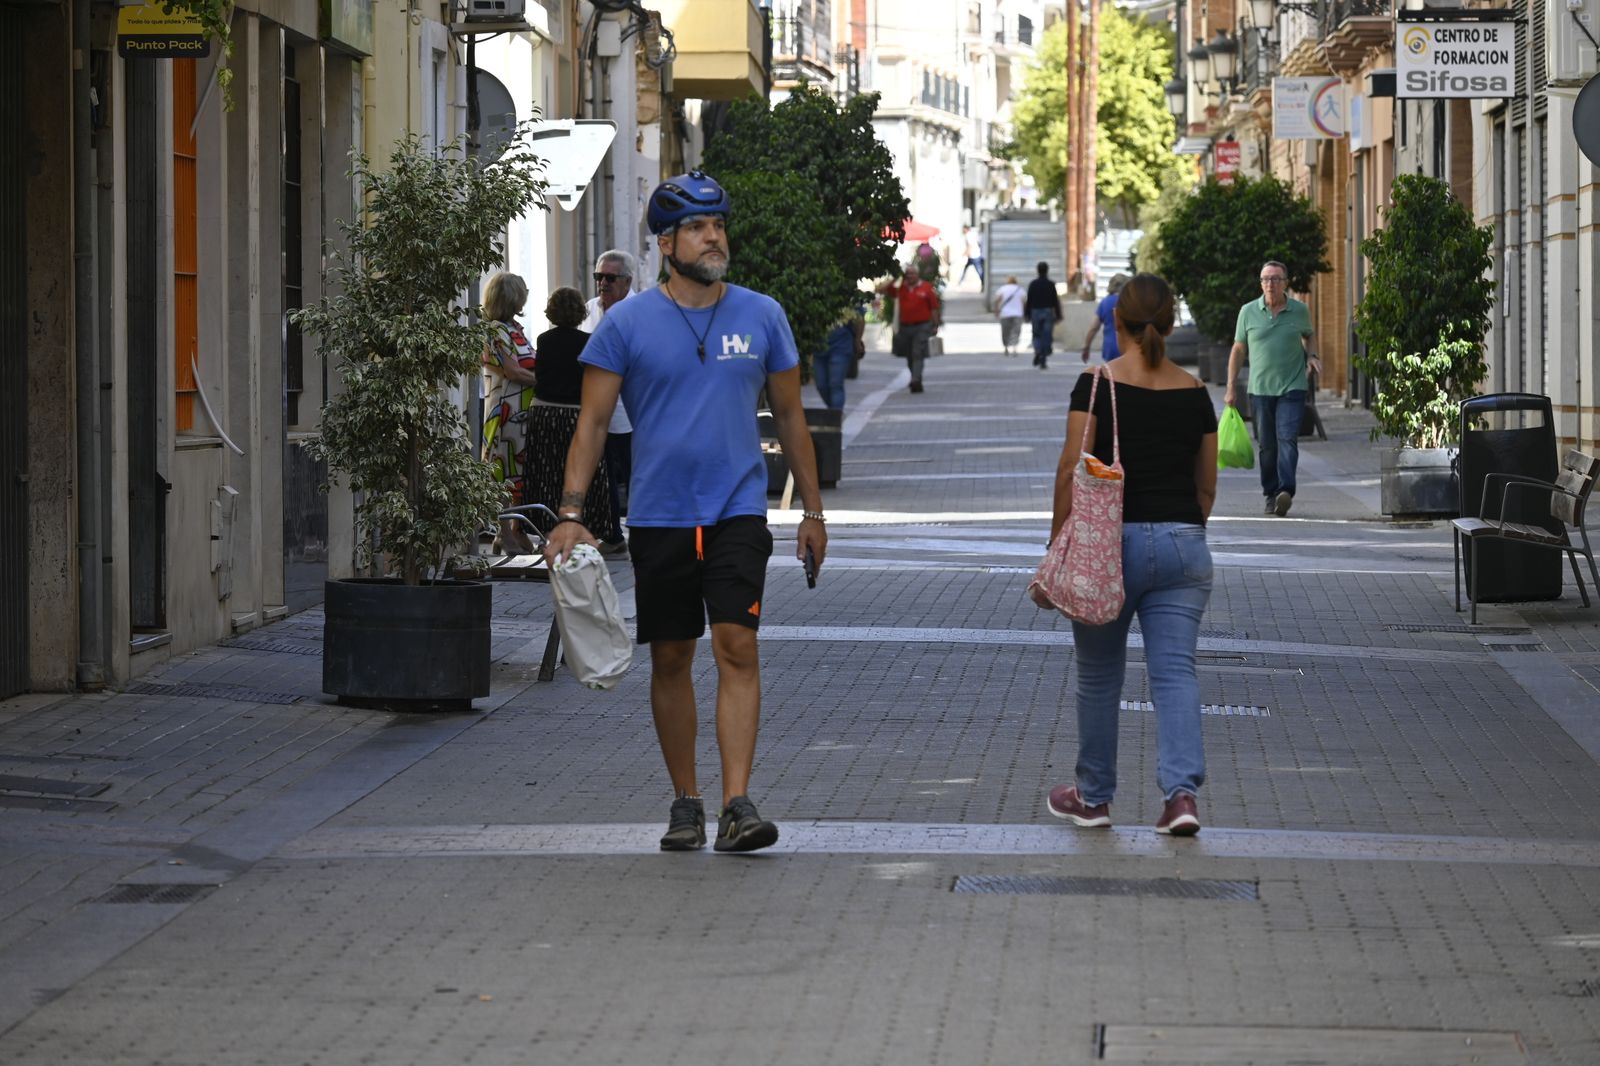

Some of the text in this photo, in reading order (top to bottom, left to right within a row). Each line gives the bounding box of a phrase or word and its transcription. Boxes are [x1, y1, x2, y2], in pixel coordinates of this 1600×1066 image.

[1434, 29, 1498, 43] CENTRO DE
[126, 40, 203, 50] Punto Pack
[1434, 50, 1509, 65] FORMACION
[1406, 70, 1507, 92] Sifosa
